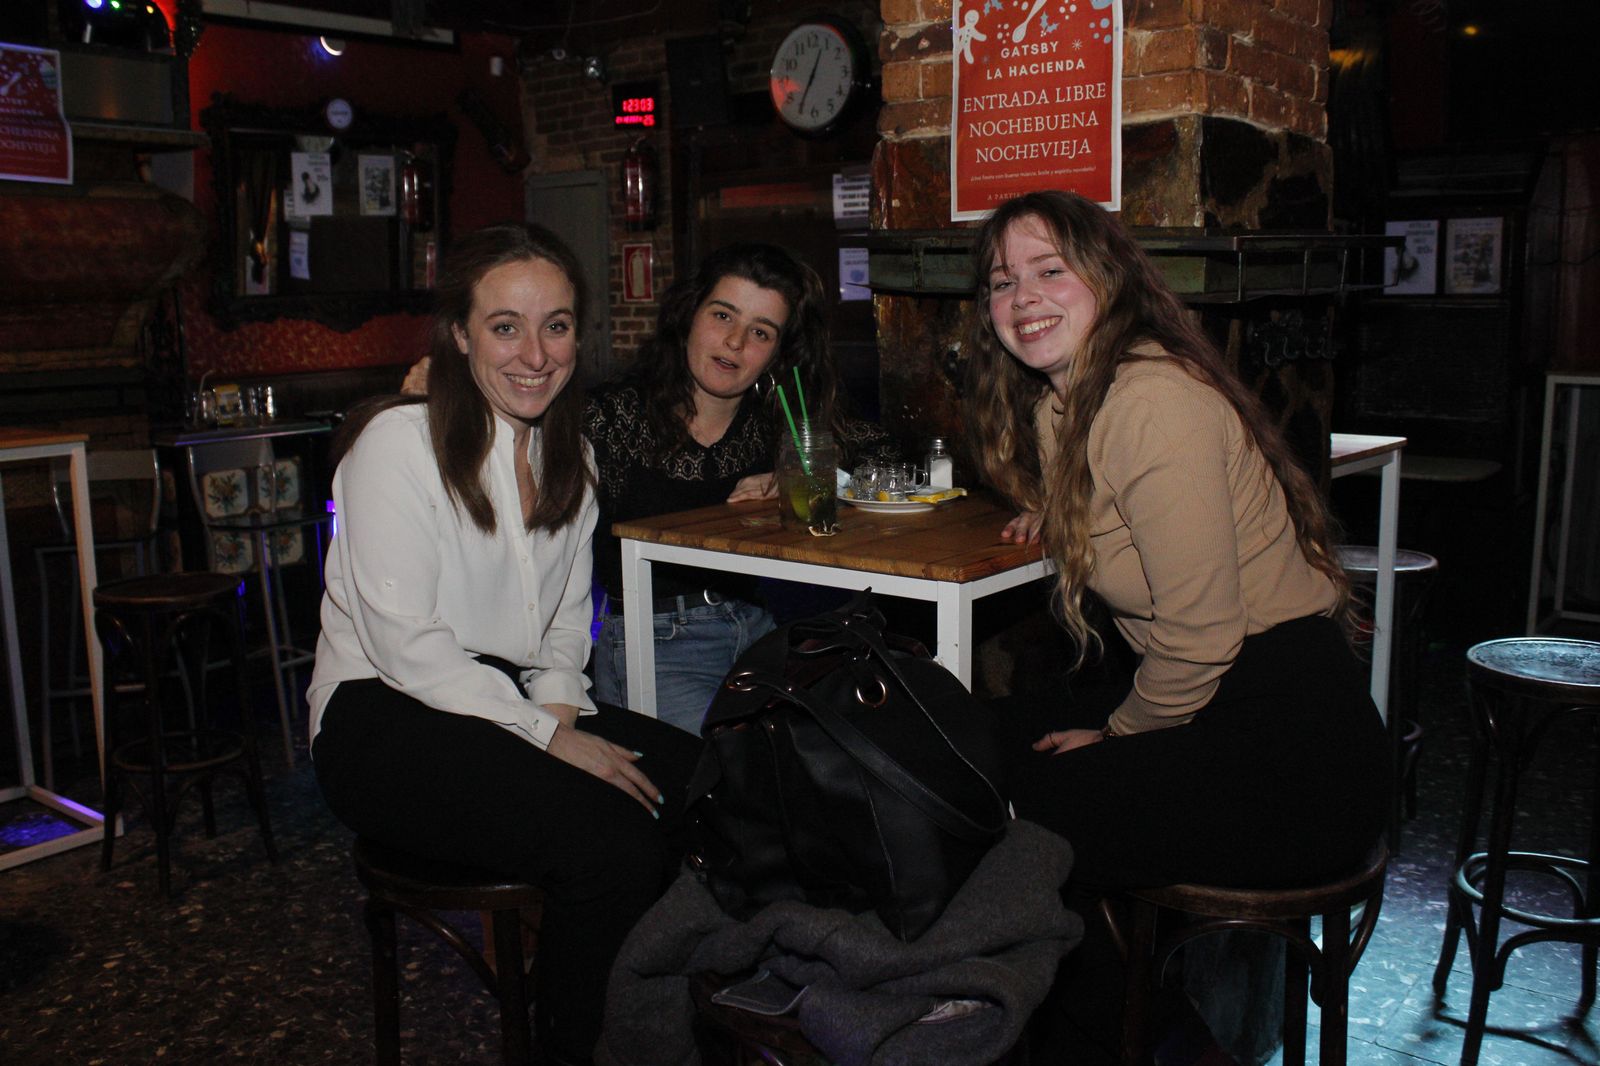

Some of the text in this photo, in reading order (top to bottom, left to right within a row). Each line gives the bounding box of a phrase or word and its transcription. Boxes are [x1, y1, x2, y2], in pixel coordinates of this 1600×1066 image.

[1001, 40, 1059, 59] GATSBY
[987, 58, 1086, 81] LA HACIENDA
[963, 83, 1106, 113] ENTRADA LIBRE
[969, 110, 1099, 138] NOCHEBUENA
[976, 138, 1092, 163] NOCHEVIEJA
